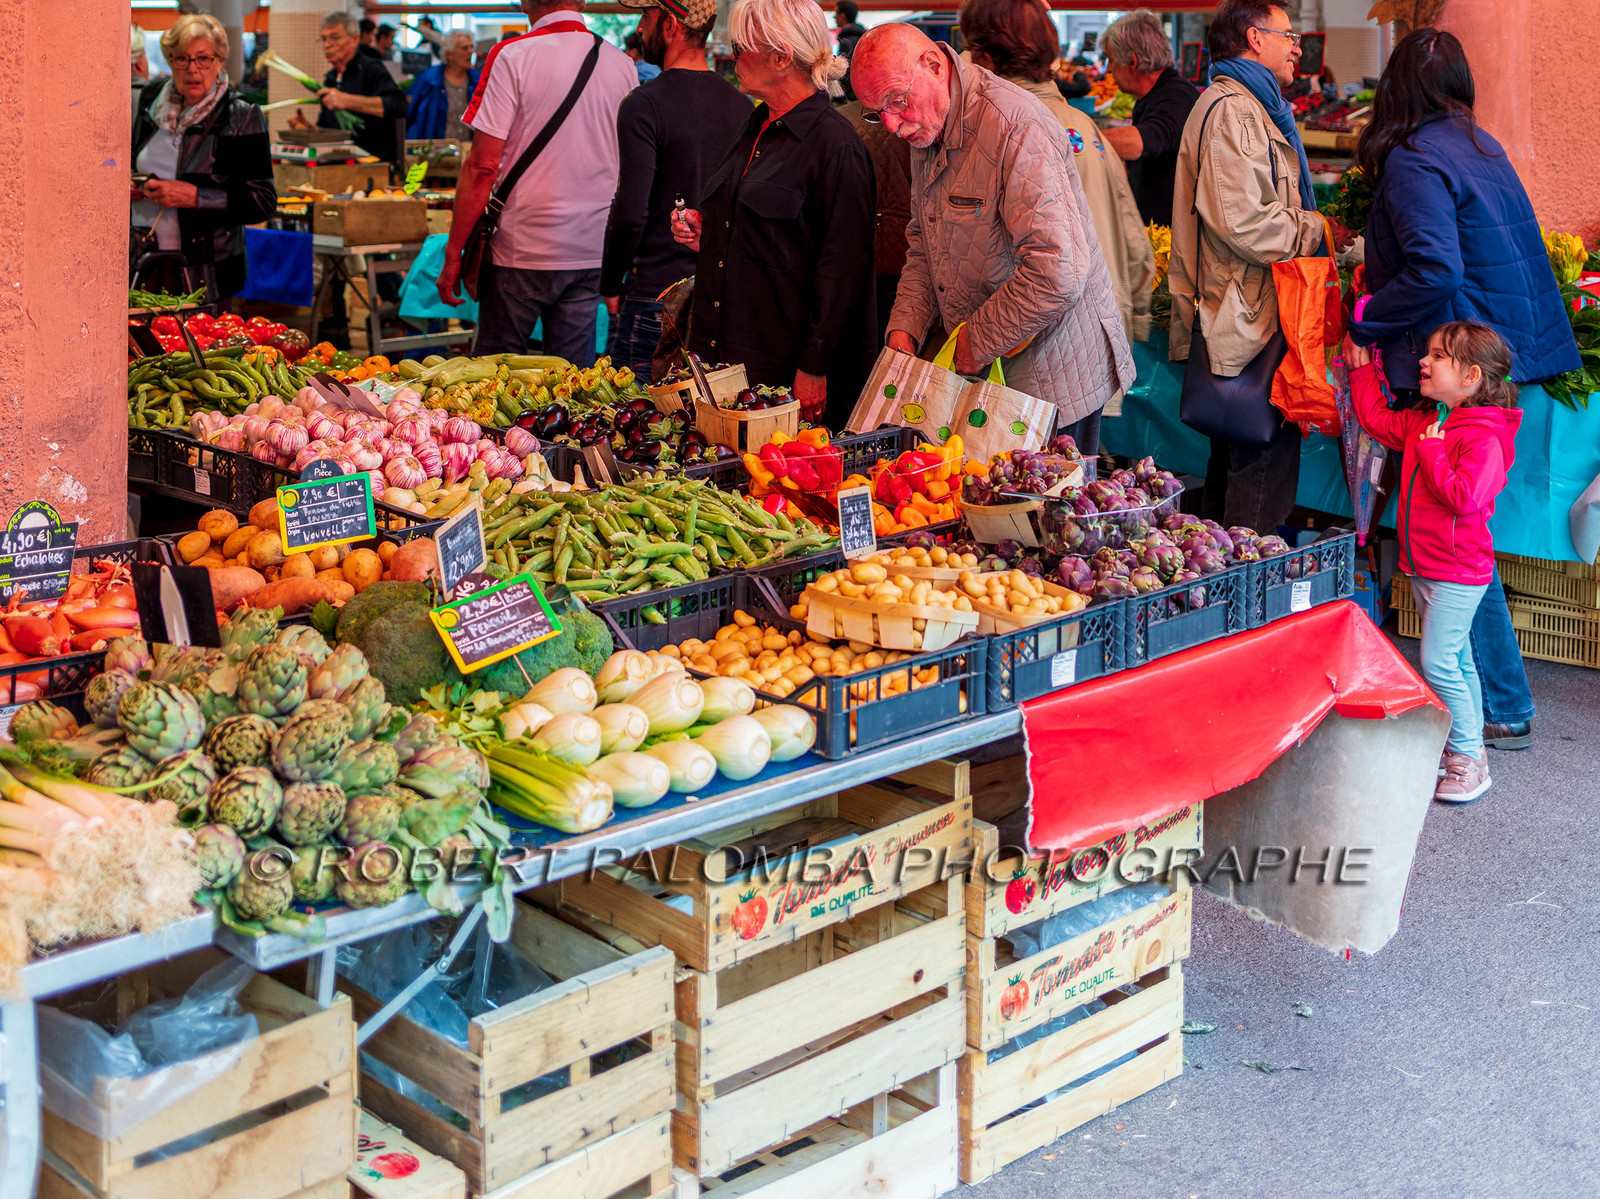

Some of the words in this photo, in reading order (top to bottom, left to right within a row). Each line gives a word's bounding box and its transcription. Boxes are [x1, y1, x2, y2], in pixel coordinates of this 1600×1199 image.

[314, 468, 333, 477] Pièce
[1, 532, 34, 554] 4,90
[36, 528, 47, 542] €
[460, 600, 490, 620] 2,90
[489, 595, 502, 607] €
[1133, 806, 1193, 850] Provence
[1029, 929, 1117, 1007] Tomate
[1065, 987, 1077, 1000] DE
[1079, 966, 1116, 993] QUALITE
